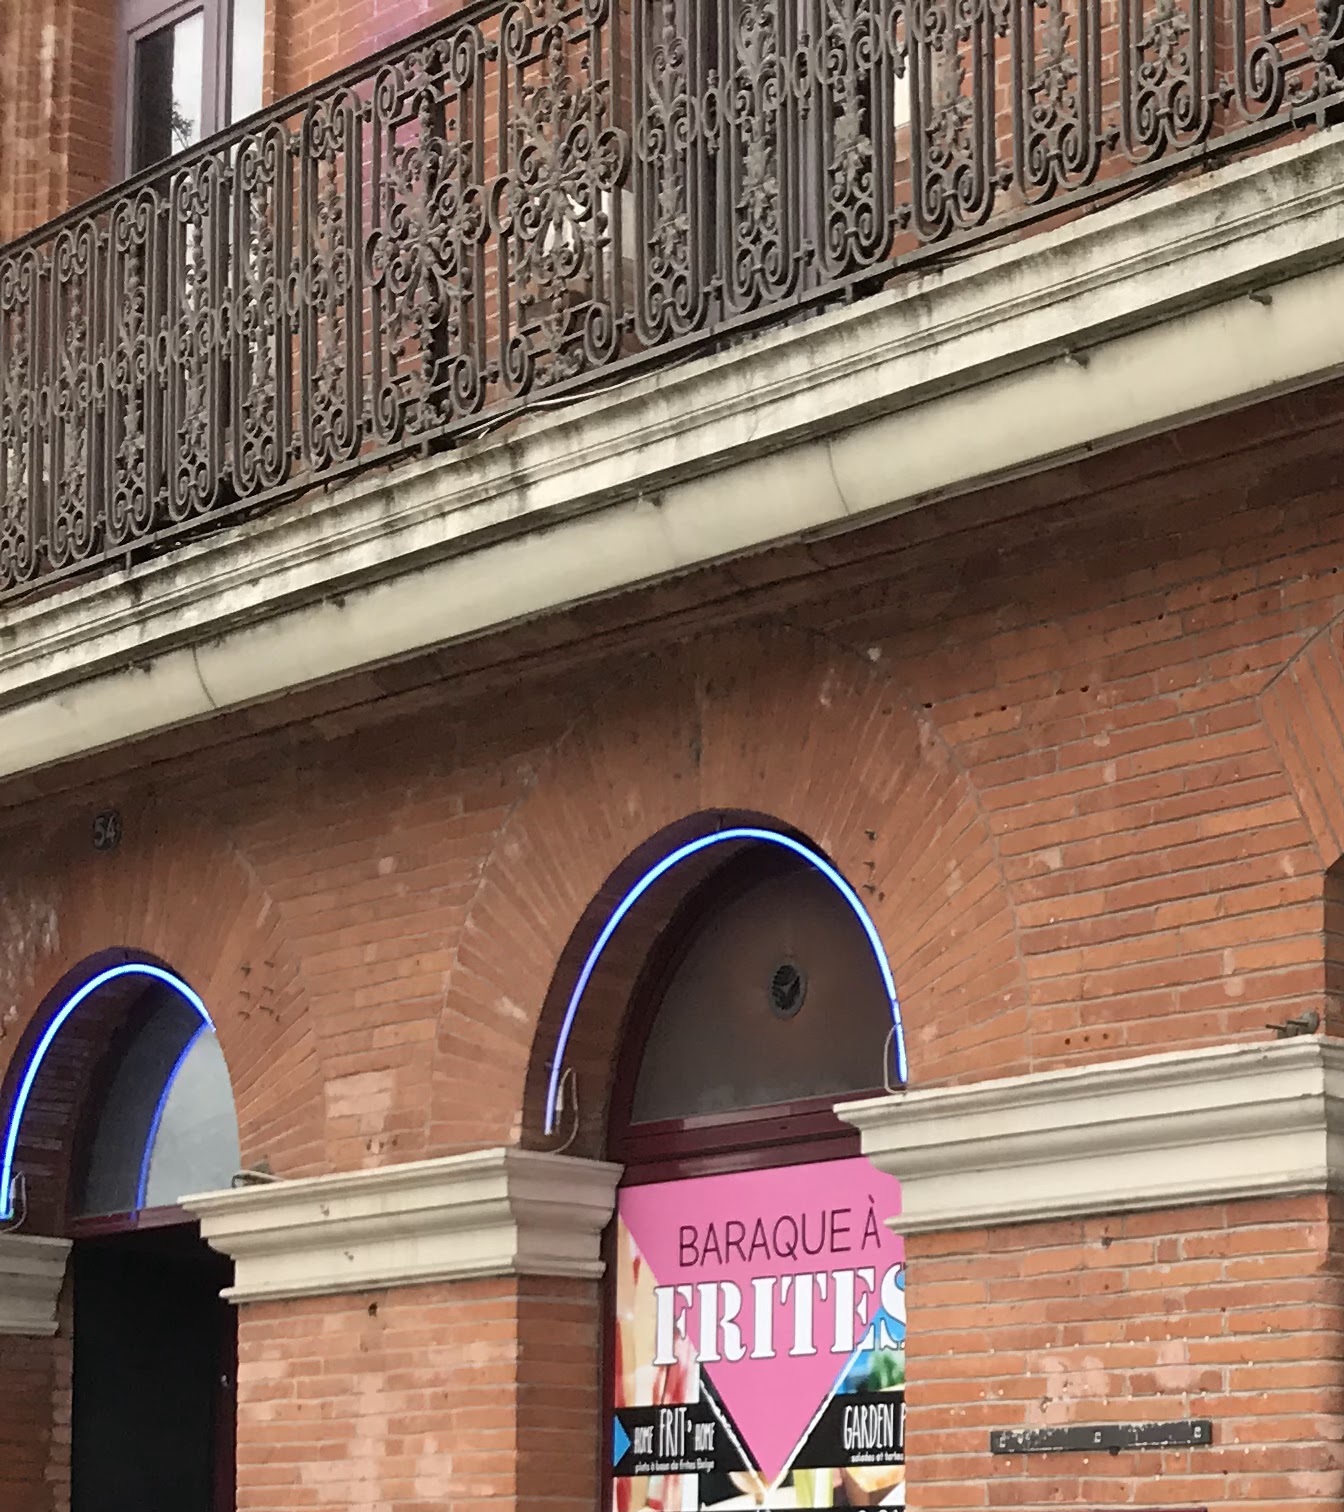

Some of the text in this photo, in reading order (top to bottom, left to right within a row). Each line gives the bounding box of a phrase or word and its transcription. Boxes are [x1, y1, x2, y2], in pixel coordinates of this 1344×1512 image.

[679, 1194, 881, 1267] BARAQUE À
[652, 1262, 906, 1366] FRITES
[843, 1403, 894, 1450] GARDEN
